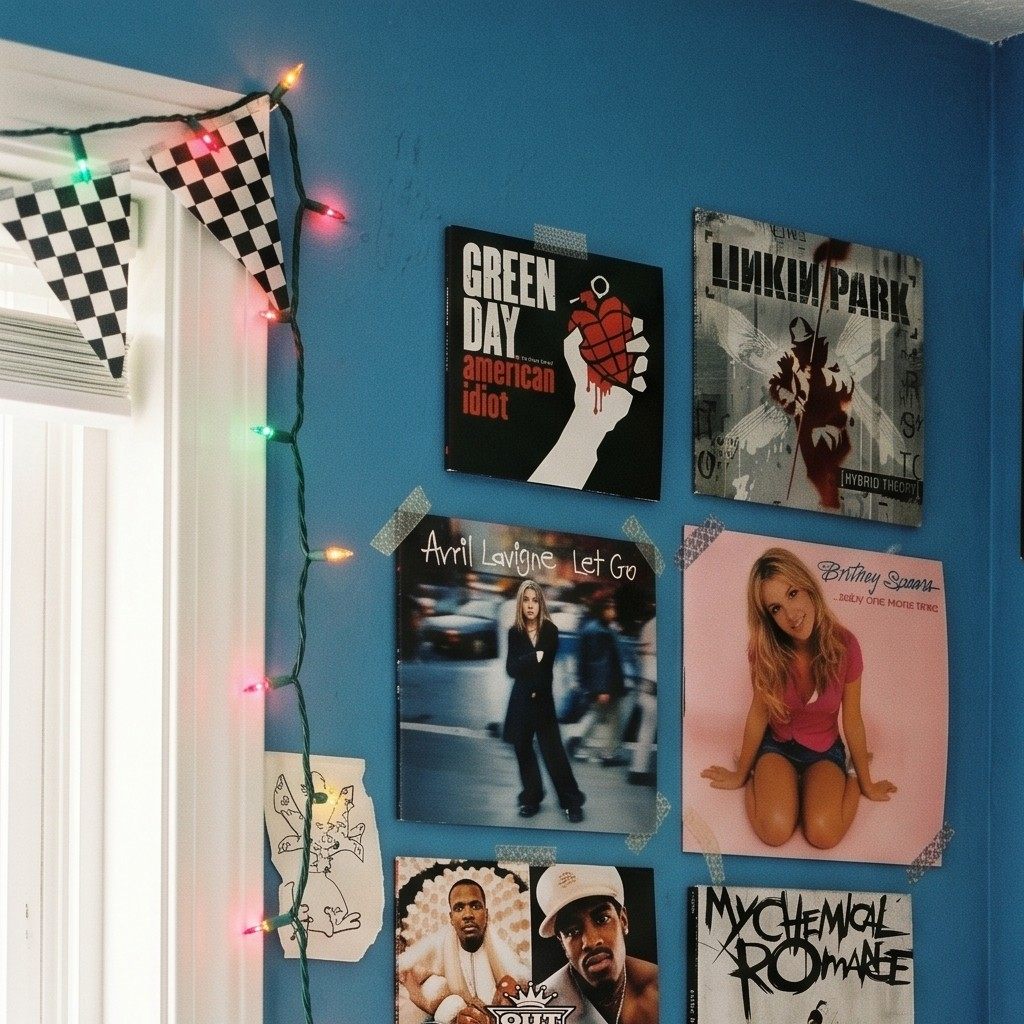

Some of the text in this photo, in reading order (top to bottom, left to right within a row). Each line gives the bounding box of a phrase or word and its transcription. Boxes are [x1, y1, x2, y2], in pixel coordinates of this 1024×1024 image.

[462, 242, 556, 313] GREEN
[712, 241, 911, 326] LINKIN PARK
[462, 298, 521, 359] DAY
[462, 353, 556, 394] american
[462, 389, 509, 421] idiot
[845, 472, 917, 495] HYBRID THEORY
[421, 528, 637, 581] Avril Lavigne Let Go
[817, 560, 881, 595] Britney
